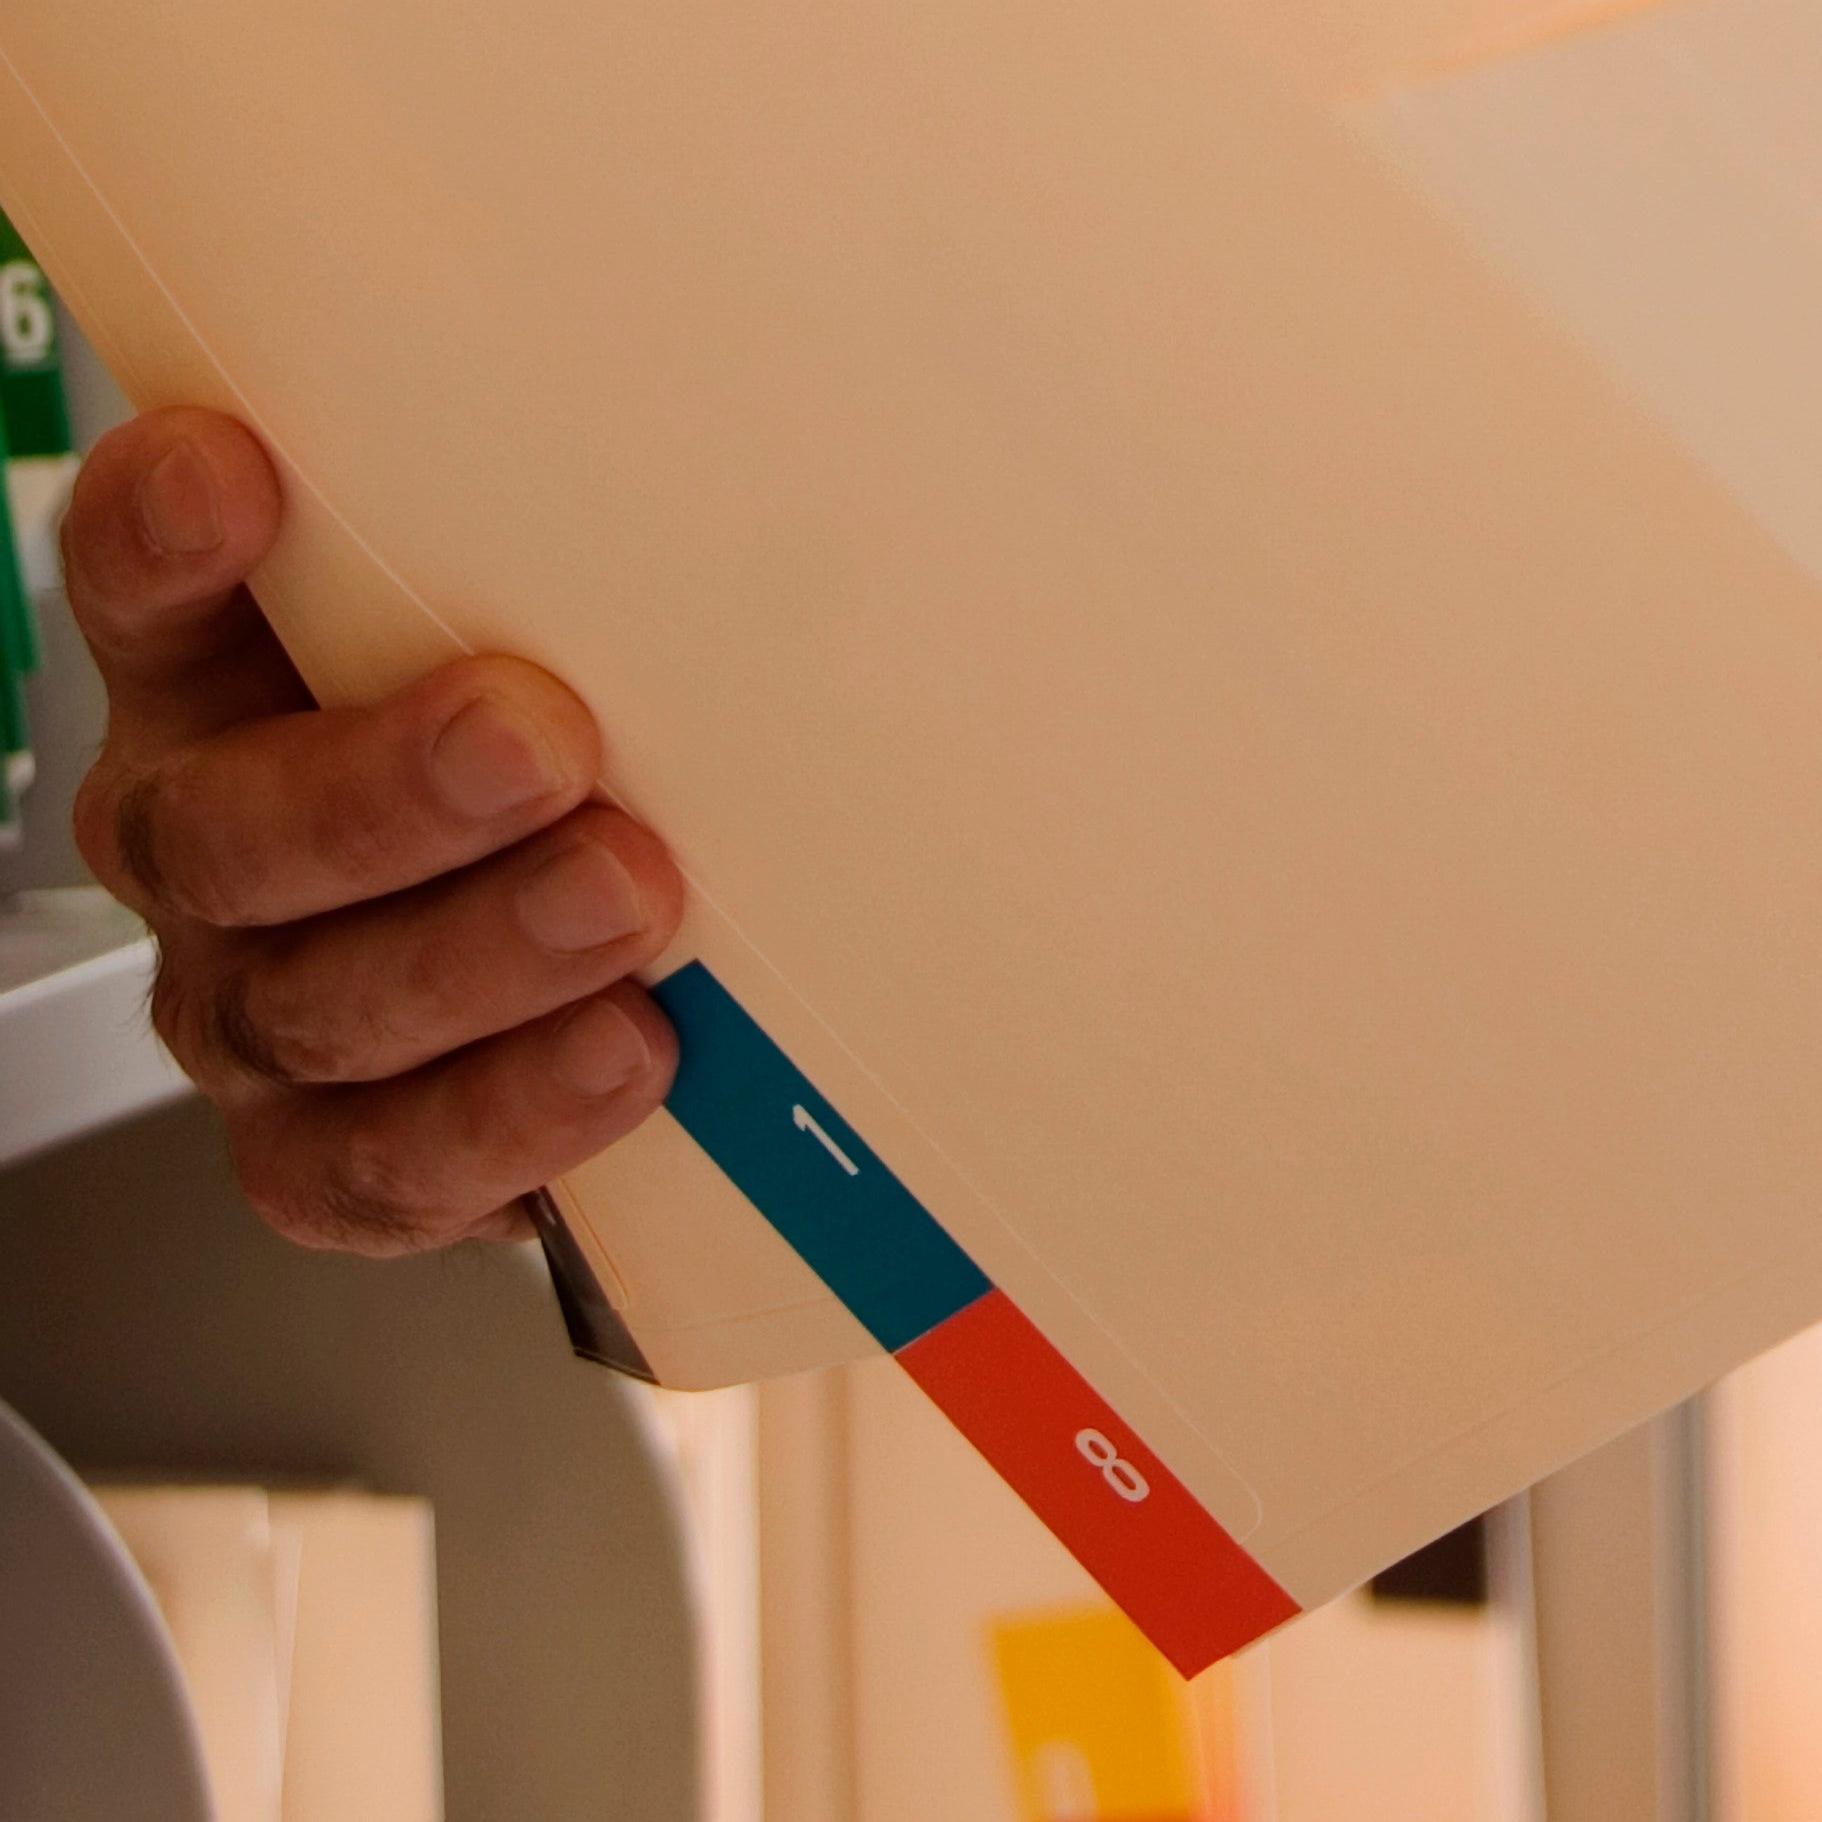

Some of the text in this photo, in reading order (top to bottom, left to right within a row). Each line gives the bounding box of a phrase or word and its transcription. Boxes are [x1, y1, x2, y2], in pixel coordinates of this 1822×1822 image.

[0, 260, 51, 362] 6
[792, 1103, 860, 1176] 1
[1075, 1428, 1150, 1503] 8
